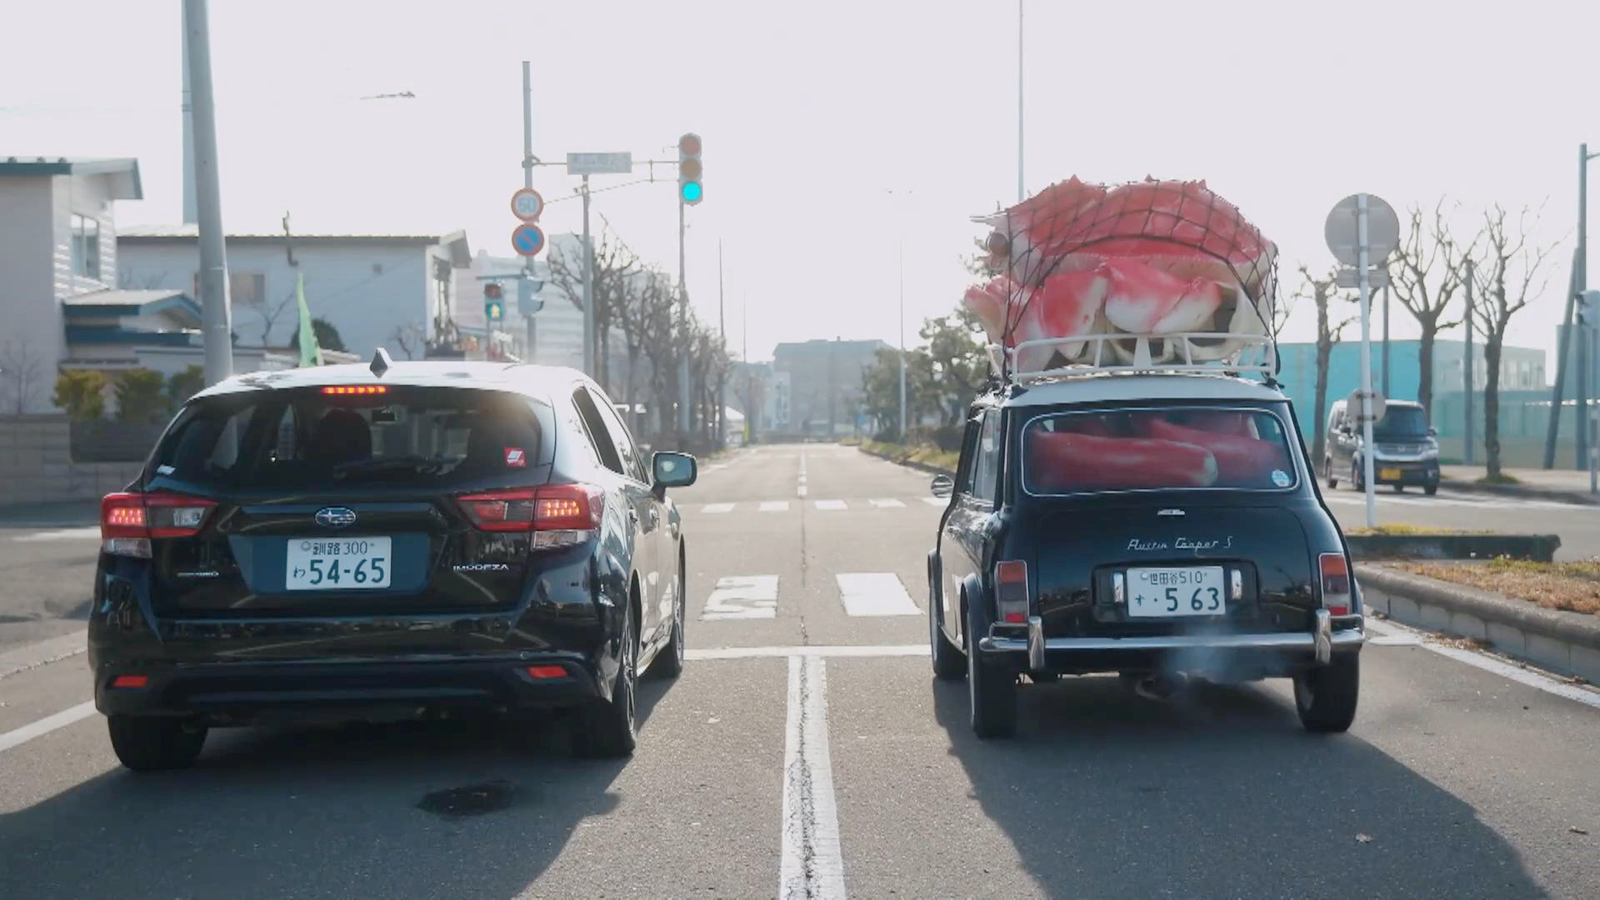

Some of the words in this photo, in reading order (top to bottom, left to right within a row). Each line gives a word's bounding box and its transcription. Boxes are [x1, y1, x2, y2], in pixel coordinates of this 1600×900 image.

[517, 197, 537, 213] 50
[312, 542, 340, 555] 釧路
[343, 541, 368, 555] 300
[1127, 539, 1167, 550] Austin
[1175, 537, 1218, 552] Cooper
[1224, 536, 1233, 549] S
[293, 566, 306, 579] わ
[309, 557, 385, 585] 54-65
